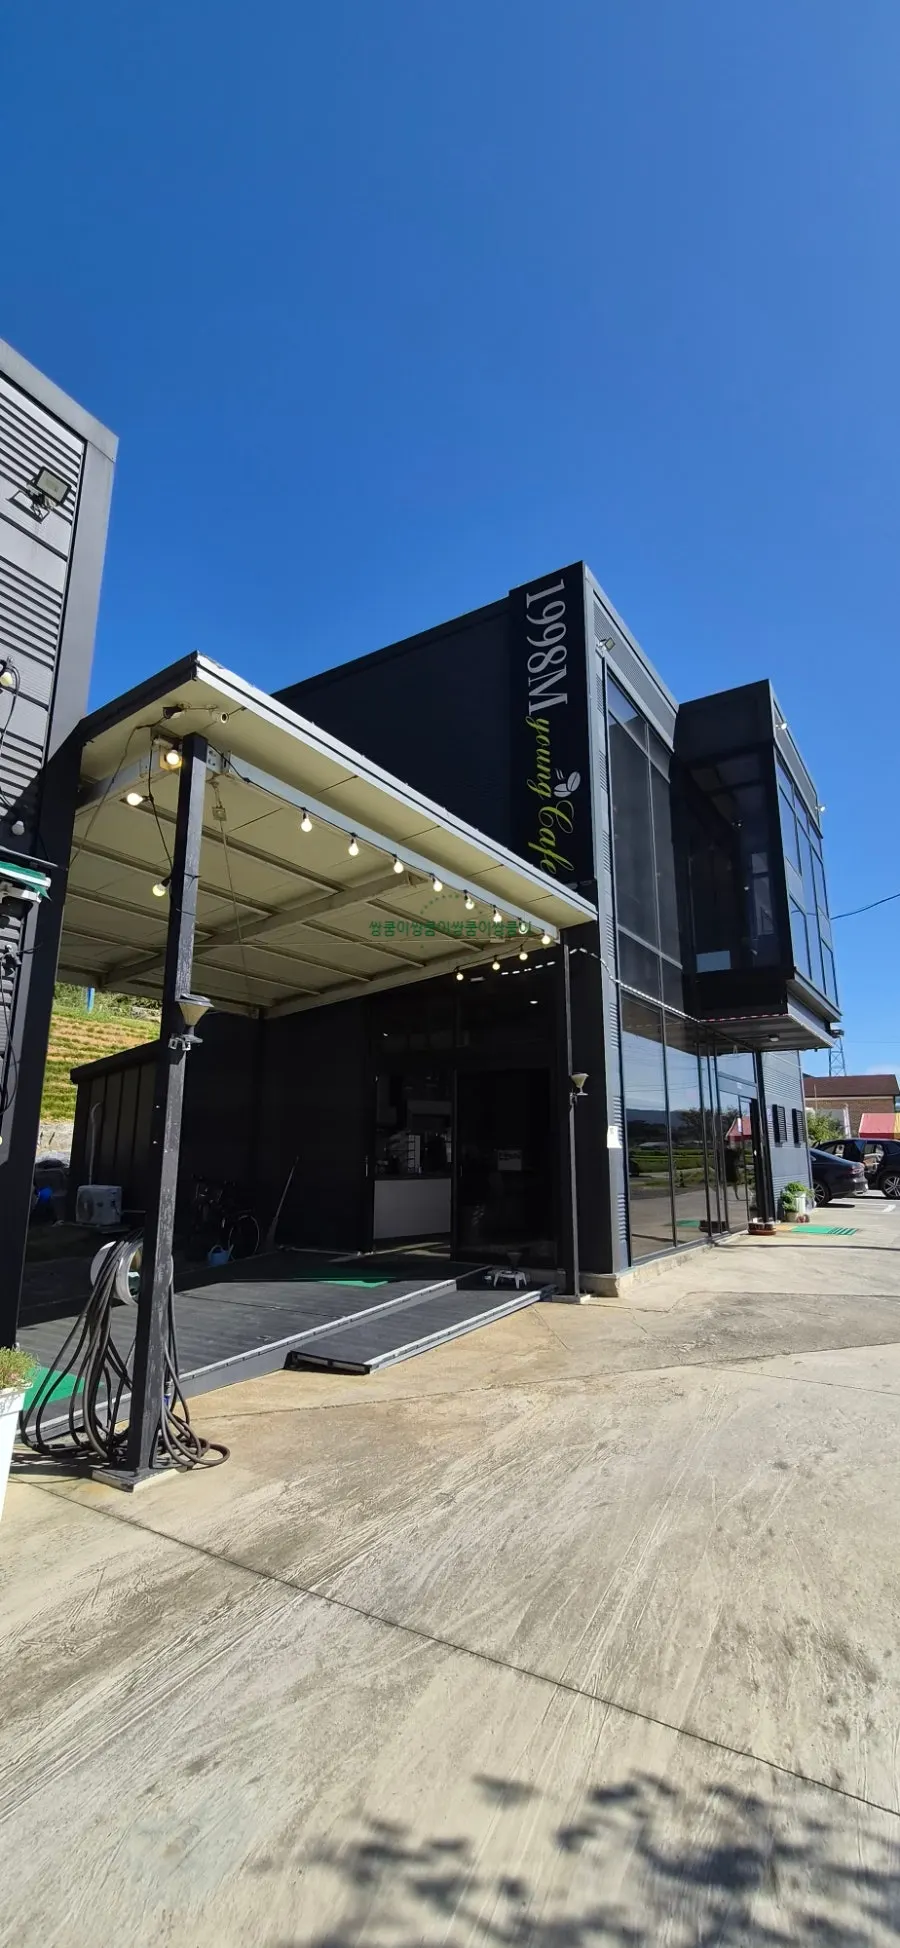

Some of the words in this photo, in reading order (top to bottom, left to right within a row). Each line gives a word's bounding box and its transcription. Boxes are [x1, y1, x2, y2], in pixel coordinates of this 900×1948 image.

[526, 578, 568, 715] 1998M
[525, 715, 552, 798] young
[528, 799, 574, 875] Cafe
